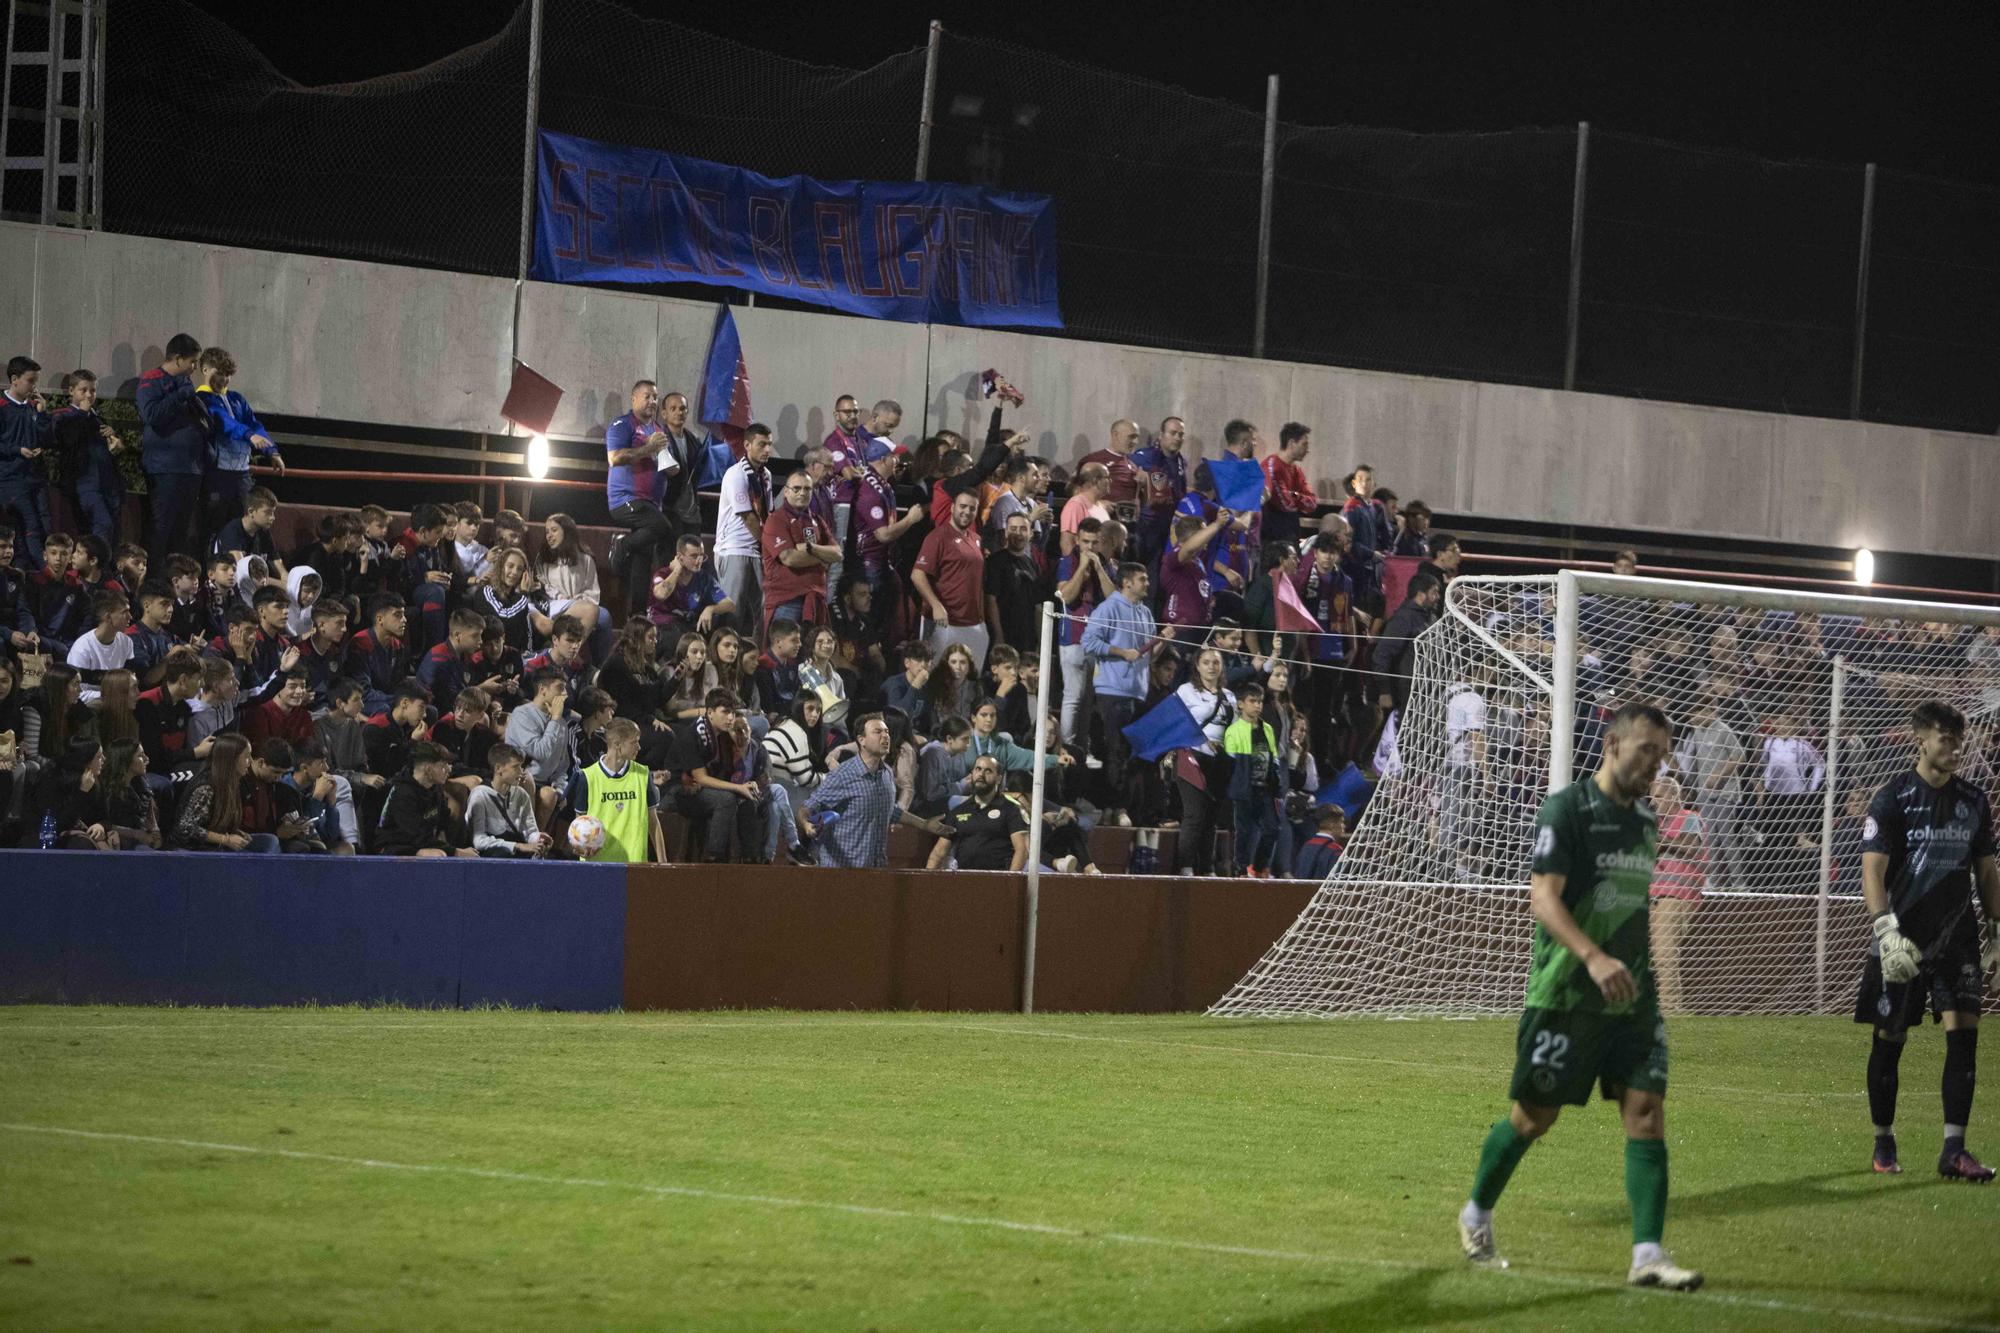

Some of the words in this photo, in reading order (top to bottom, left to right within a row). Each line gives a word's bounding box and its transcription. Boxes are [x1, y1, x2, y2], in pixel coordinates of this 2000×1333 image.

[749, 196, 1040, 307] BLAUGRANA
[1906, 825, 1970, 841] columbia
[1531, 1029, 1569, 1069] 22
